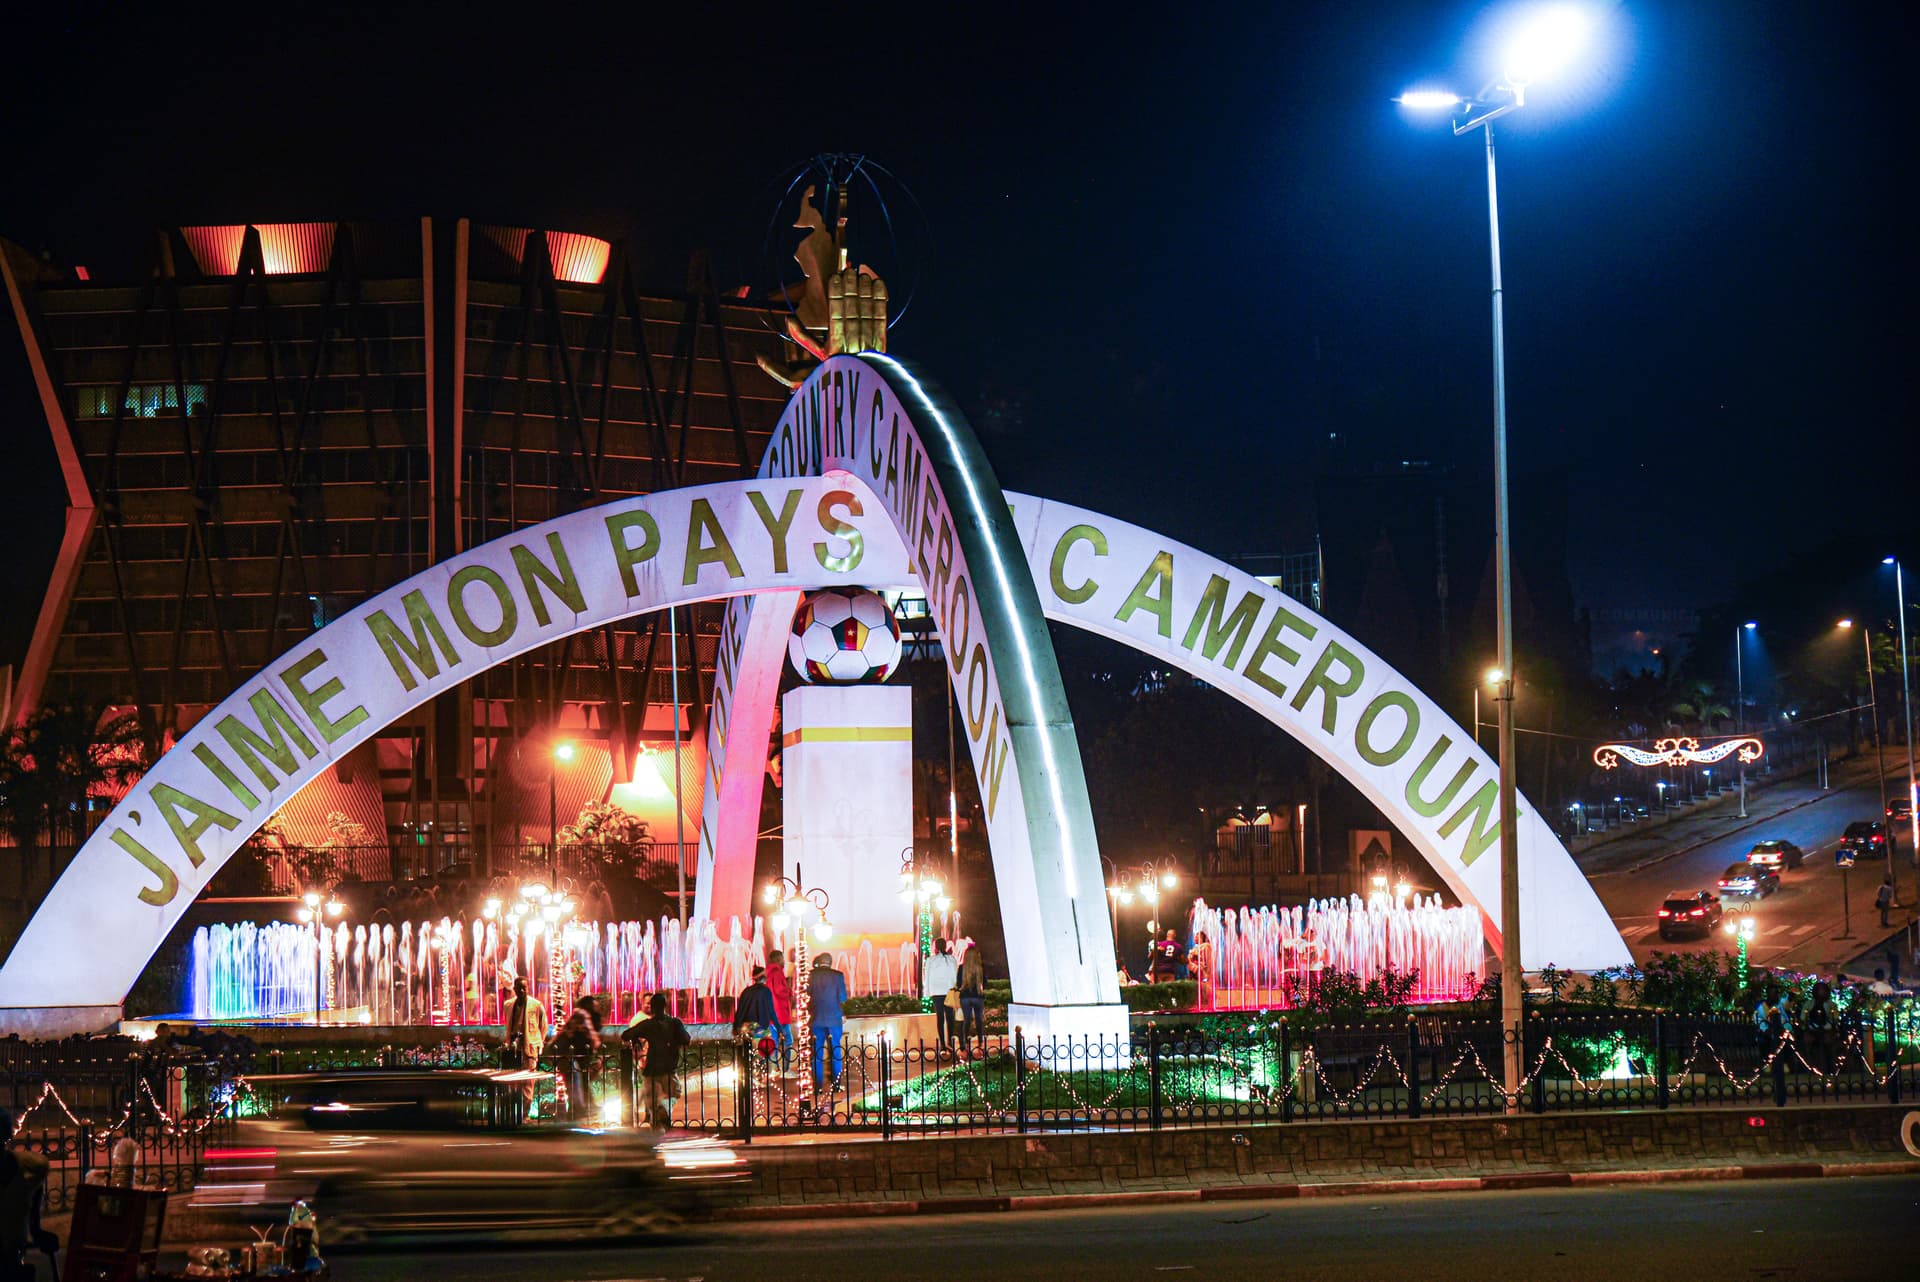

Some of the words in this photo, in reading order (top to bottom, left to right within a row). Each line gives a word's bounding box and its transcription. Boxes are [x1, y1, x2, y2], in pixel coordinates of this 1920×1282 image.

[110, 648, 371, 906] J'AIME
[365, 531, 588, 692] MON
[605, 489, 865, 598] PAYS
[1050, 524, 1522, 868] CAMEROUN
[708, 597, 741, 801] LOVE
[870, 388, 1008, 824] CAMEROON
[1165, 944, 1175, 957] 2
